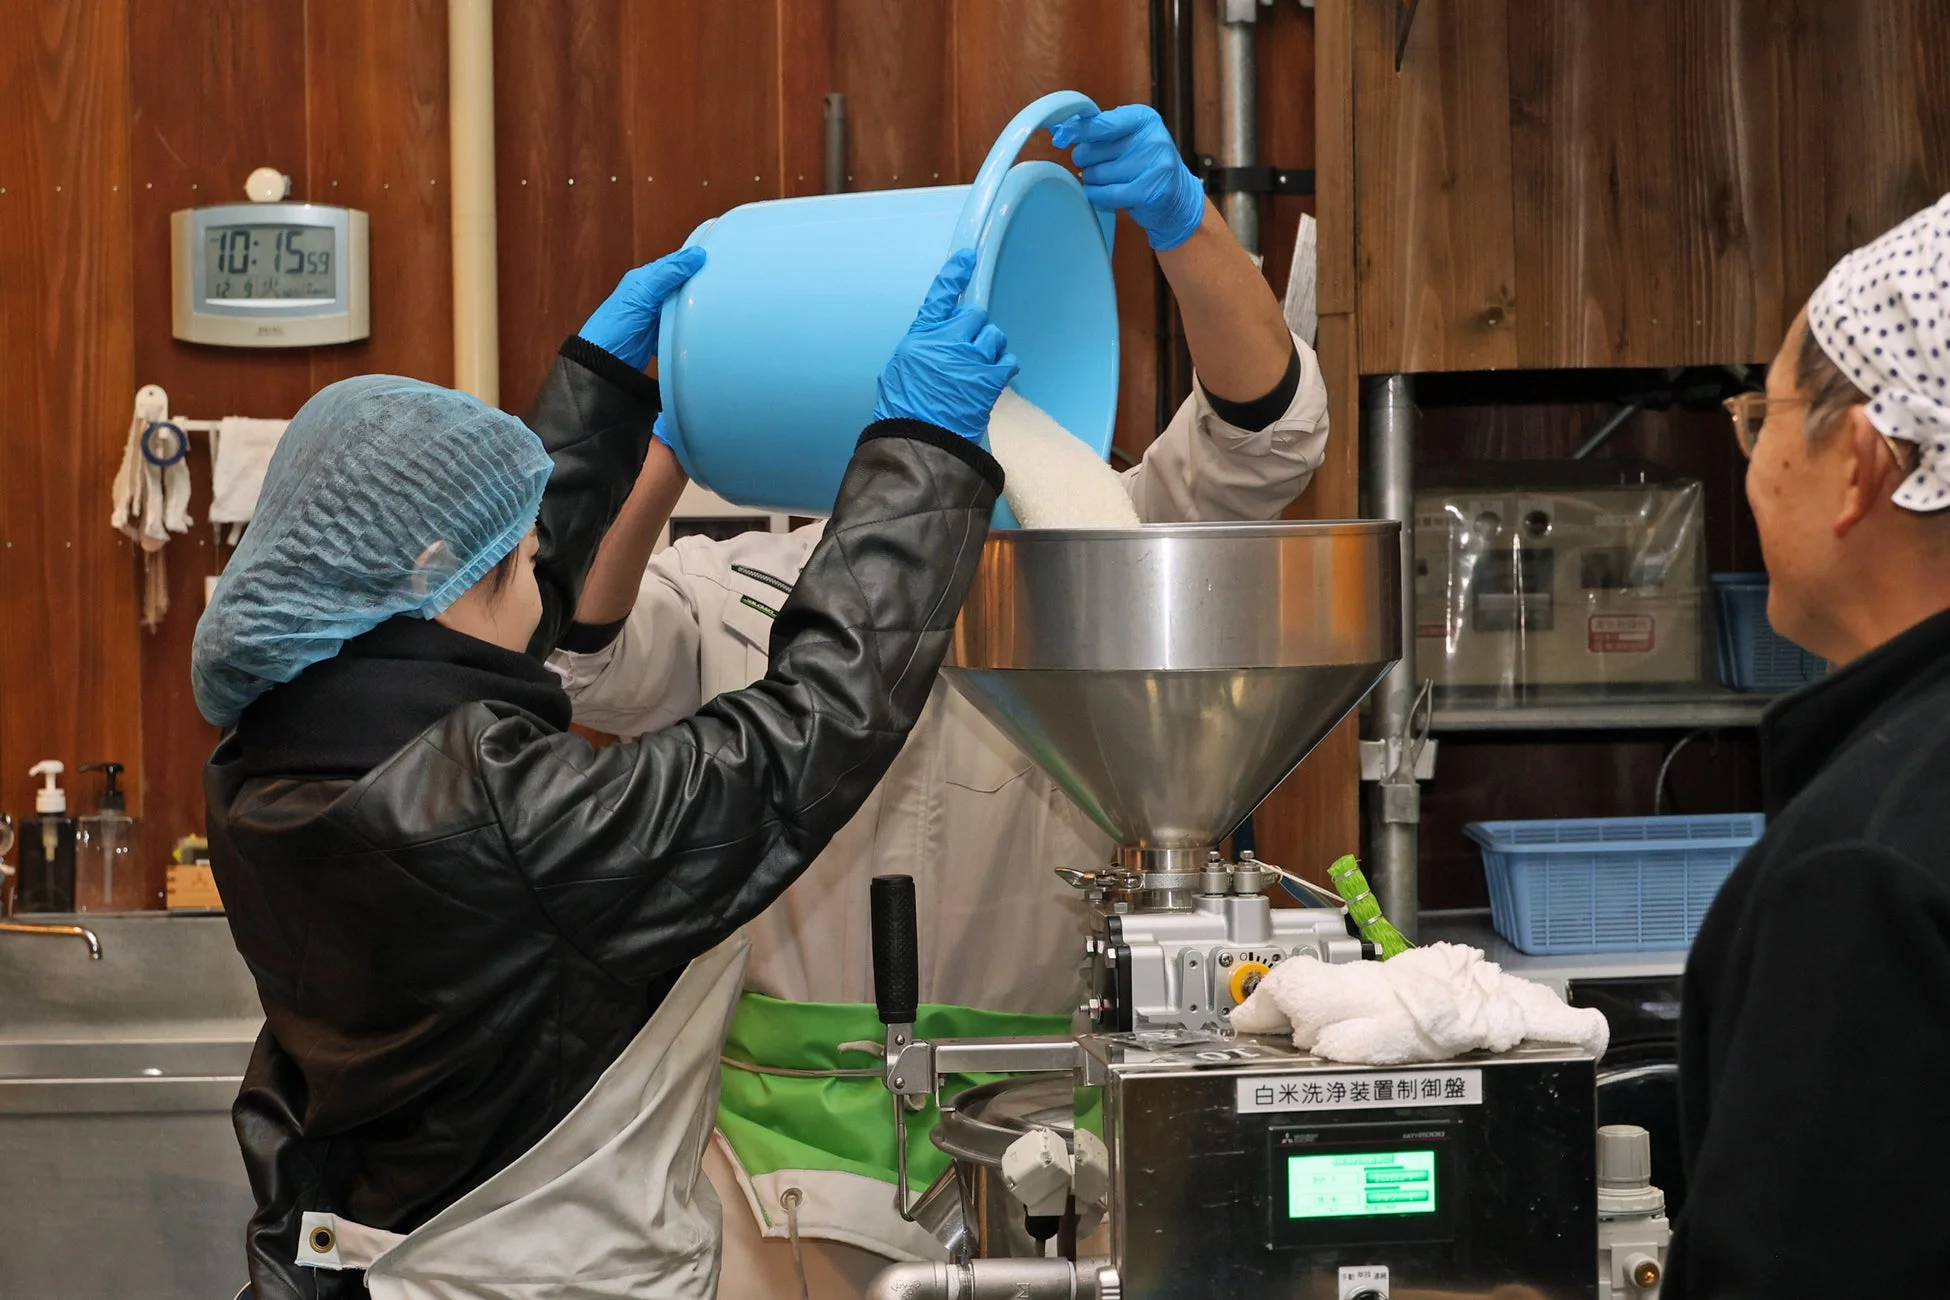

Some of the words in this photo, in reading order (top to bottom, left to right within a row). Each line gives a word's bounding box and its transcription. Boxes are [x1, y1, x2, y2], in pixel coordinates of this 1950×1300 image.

[218, 231, 304, 274] 10:15
[306, 251, 330, 275] 59
[1255, 1077, 1466, 1106] 白米洗浄装置制御盤
